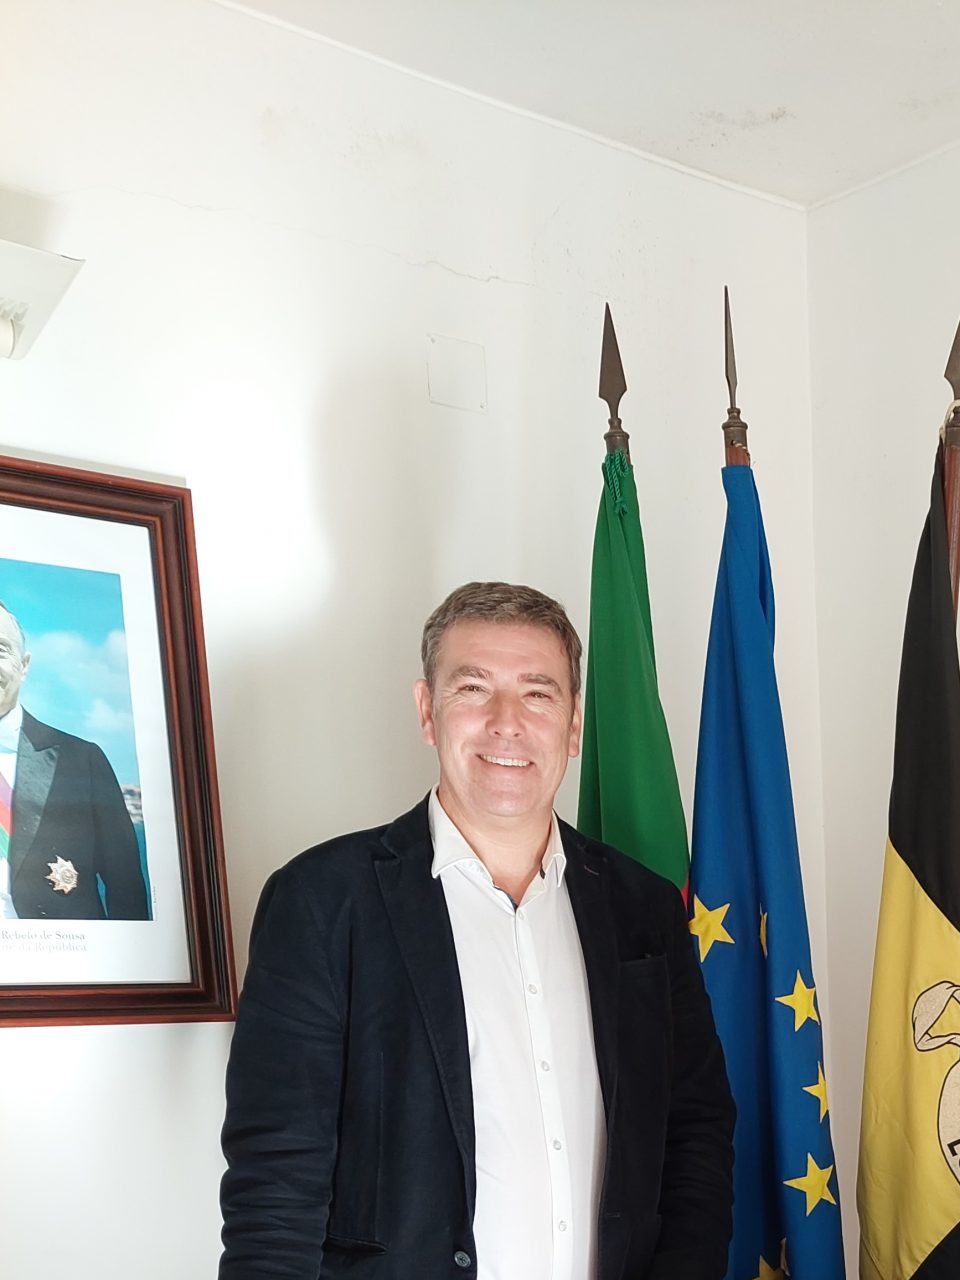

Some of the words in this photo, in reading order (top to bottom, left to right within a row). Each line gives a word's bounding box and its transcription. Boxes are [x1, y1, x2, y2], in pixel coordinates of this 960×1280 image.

[1, 929, 37, 940] Rebelo
[40, 929, 52, 940] de
[55, 930, 85, 940] Sousa
